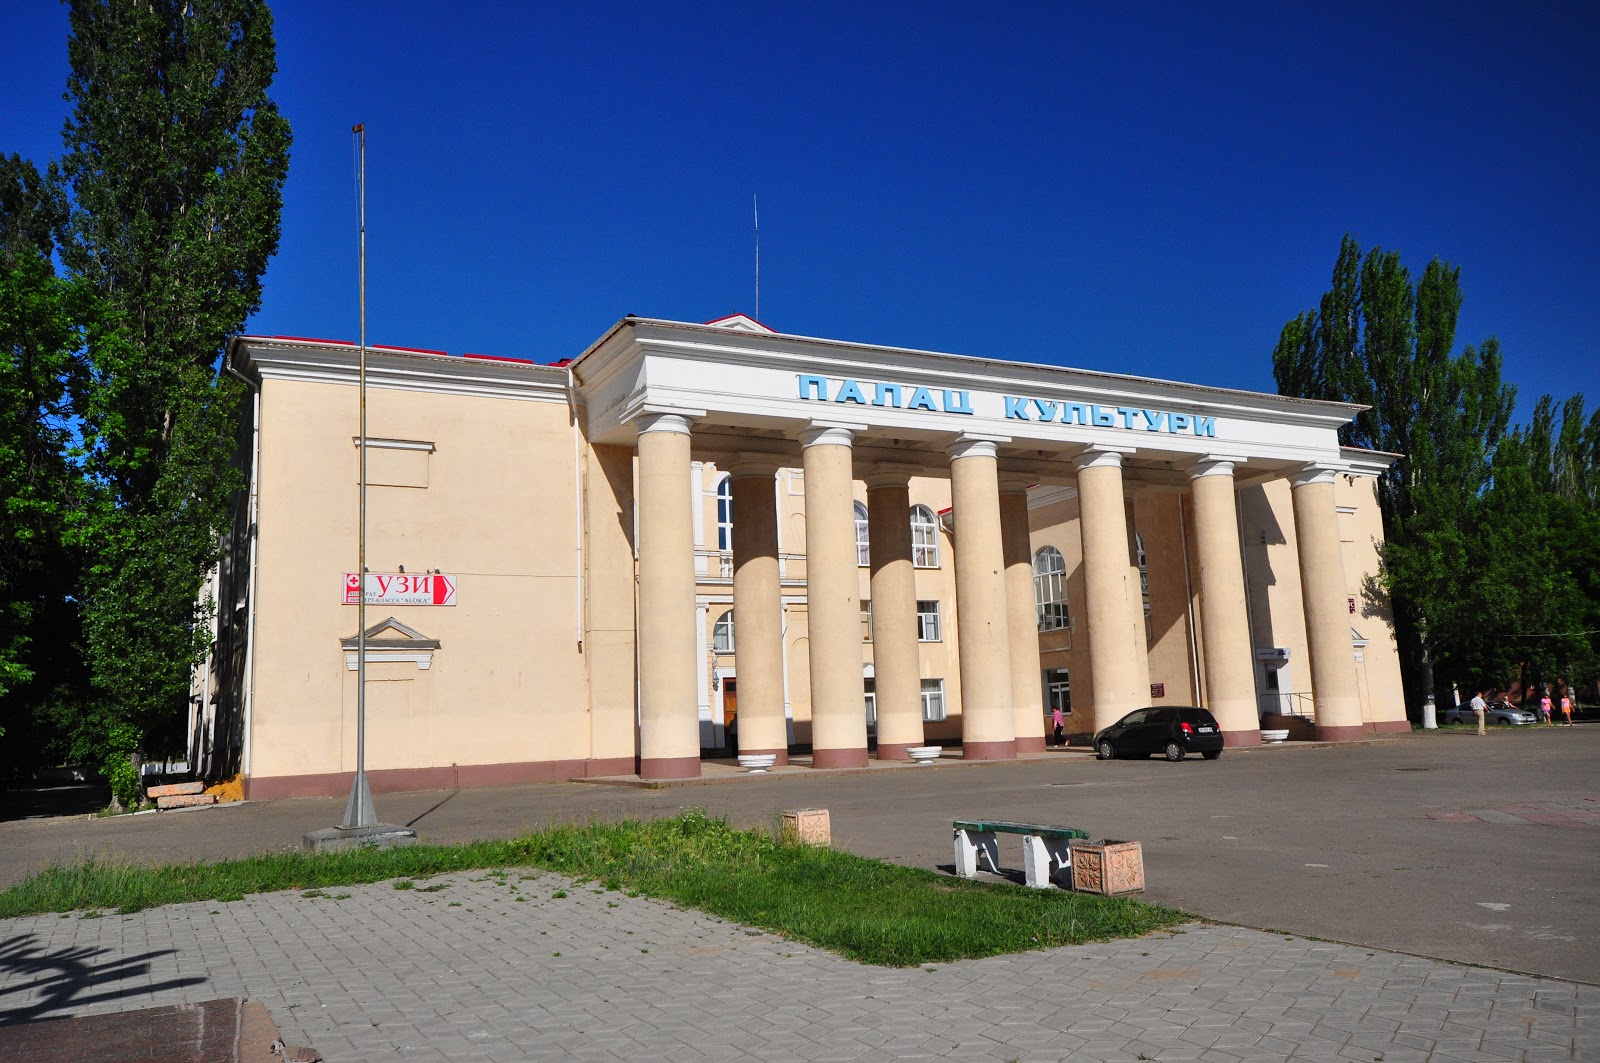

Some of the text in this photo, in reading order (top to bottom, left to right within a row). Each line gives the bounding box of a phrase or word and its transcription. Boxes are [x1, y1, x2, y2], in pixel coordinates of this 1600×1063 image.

[797, 374, 1217, 437] ПАЛАЦ КУЛЬТУРИ
[375, 575, 430, 598] УЗИ
